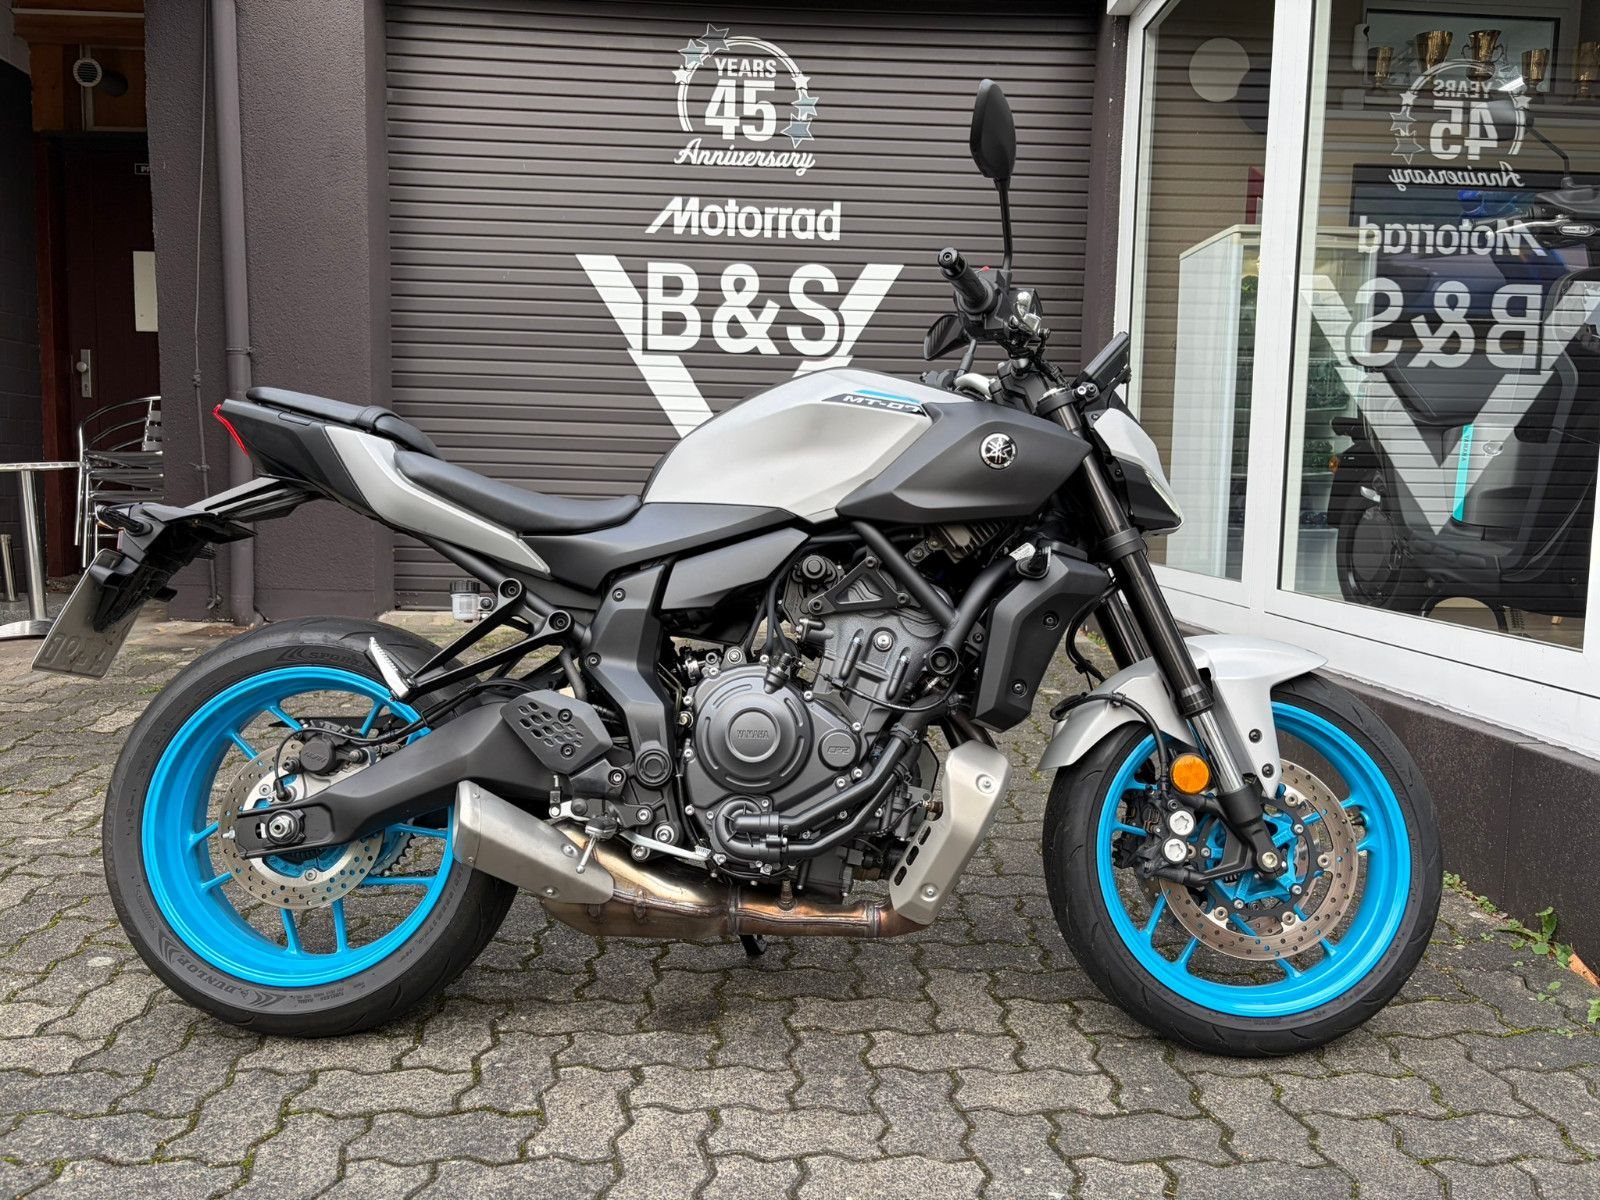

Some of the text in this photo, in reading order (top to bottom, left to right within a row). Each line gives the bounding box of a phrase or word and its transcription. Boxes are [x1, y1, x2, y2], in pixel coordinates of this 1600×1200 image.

[714, 58, 777, 79] YEARS
[704, 79, 777, 142] 45
[673, 138, 816, 176] Anniversary
[645, 196, 842, 241] Motorrad
[842, 395, 921, 411] MT-07
[736, 729, 769, 739] YAMAHA
[177, 954, 239, 994] DUNLOP
